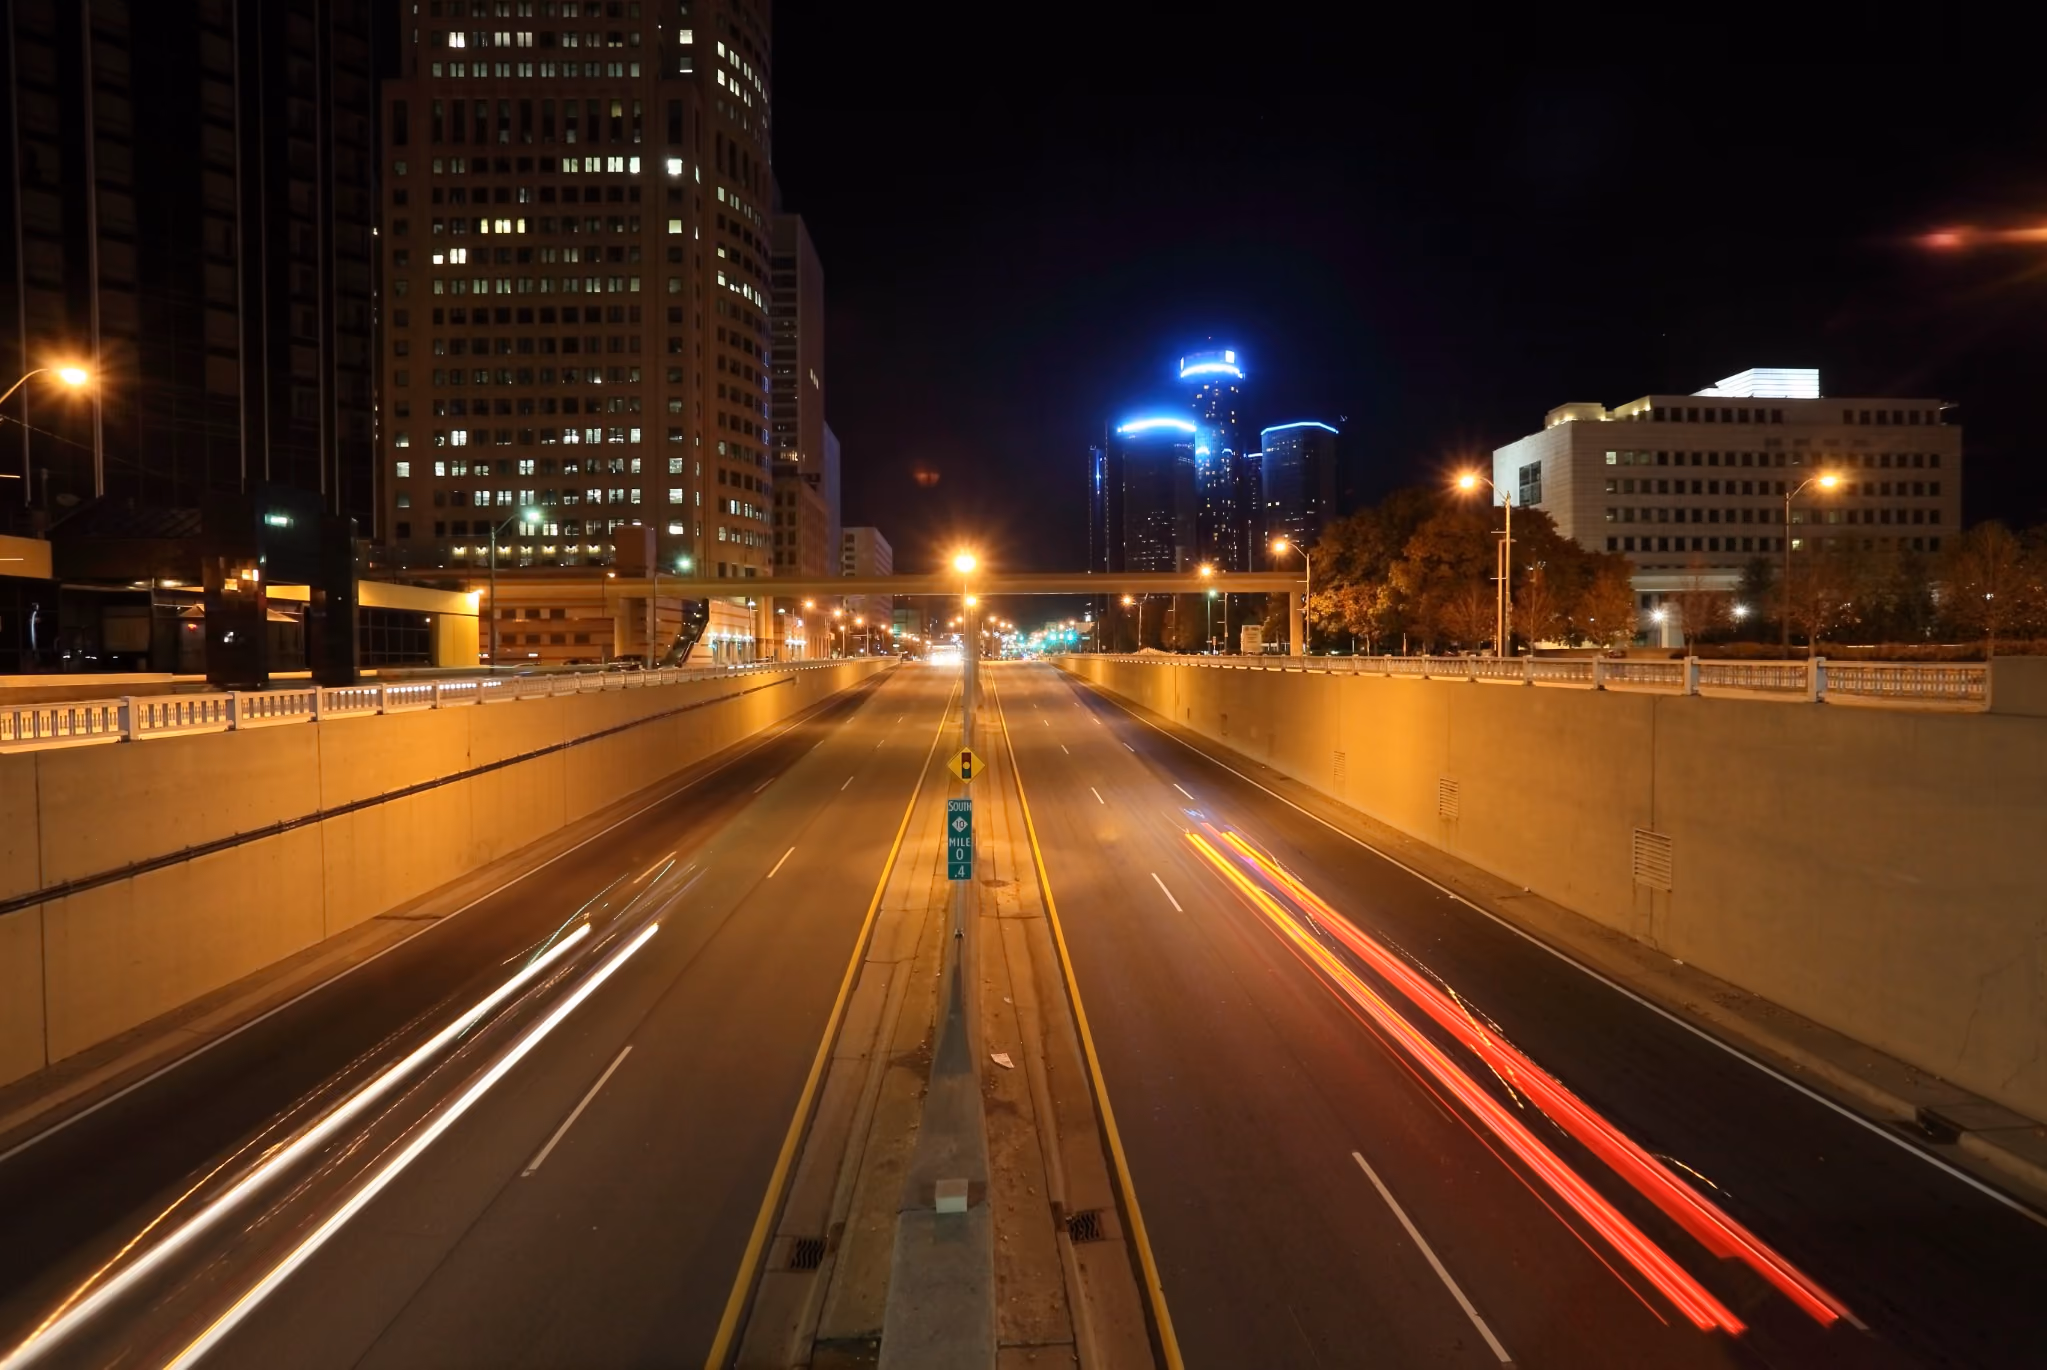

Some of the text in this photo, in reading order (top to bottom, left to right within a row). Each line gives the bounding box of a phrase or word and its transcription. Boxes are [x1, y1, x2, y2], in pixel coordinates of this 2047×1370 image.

[948, 801, 972, 811] SOUTH
[955, 820, 965, 828] 10
[949, 838, 971, 847] MILE
[956, 848, 964, 860] 0
